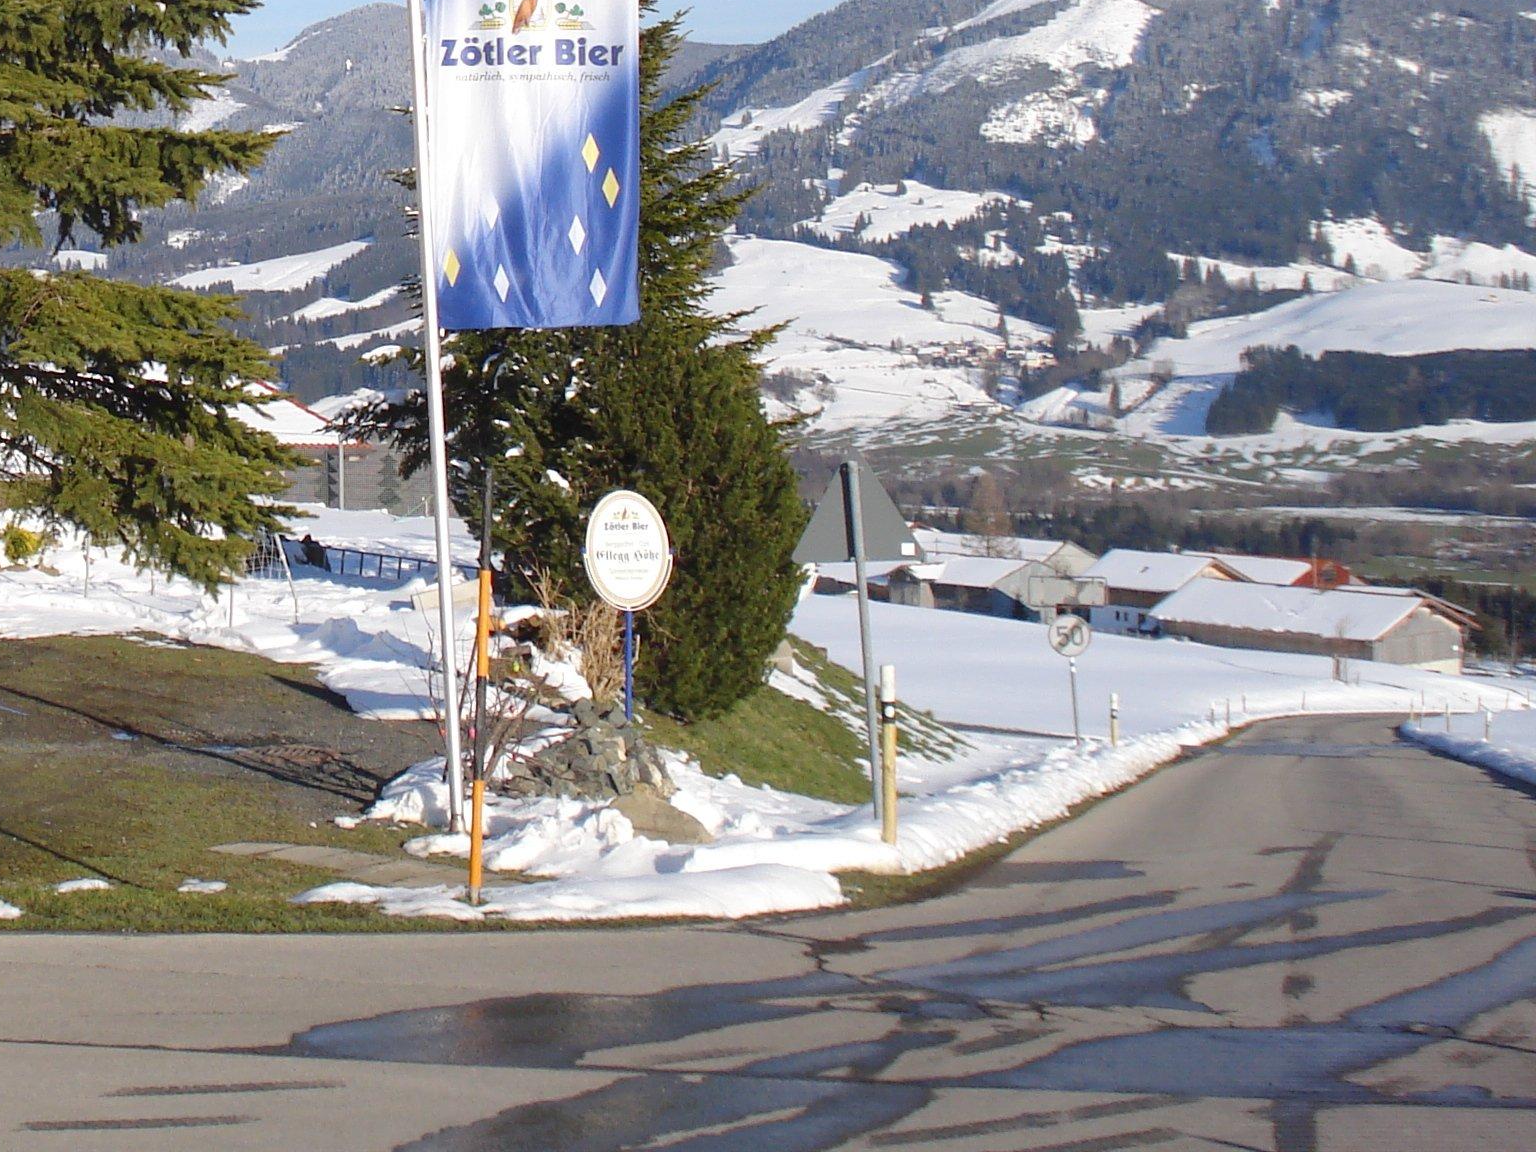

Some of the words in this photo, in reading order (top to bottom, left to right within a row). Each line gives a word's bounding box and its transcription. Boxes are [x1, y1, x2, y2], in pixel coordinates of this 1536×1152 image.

[441, 37, 542, 67] Zötler
[555, 37, 624, 67] Bier
[455, 71, 505, 82] natürlich,
[579, 71, 611, 83] frisch
[1056, 625, 1084, 647] 50
